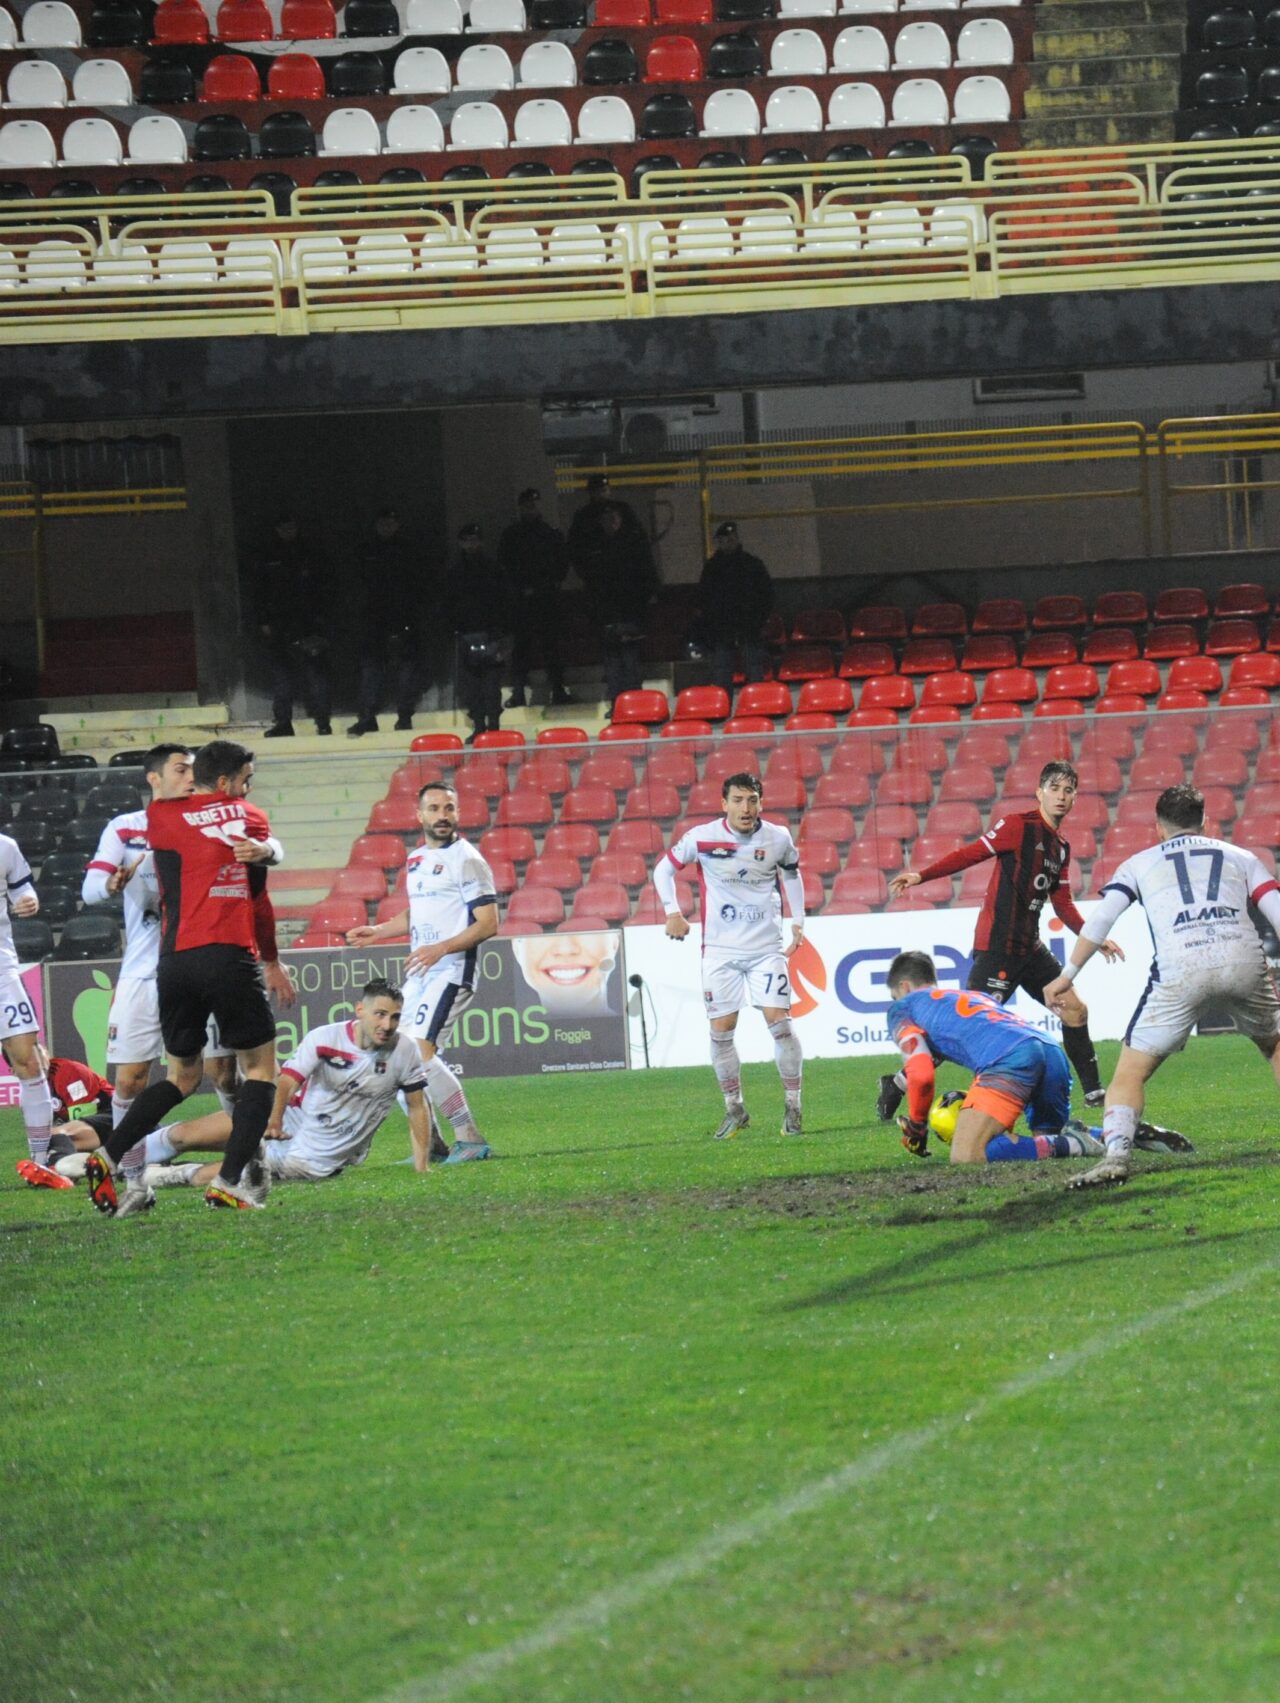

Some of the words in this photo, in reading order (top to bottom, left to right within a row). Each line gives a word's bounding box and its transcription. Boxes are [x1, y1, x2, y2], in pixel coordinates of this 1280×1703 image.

[181, 803, 248, 827] BERETTA
[1165, 848, 1225, 905] 17
[763, 973, 789, 996] 72
[4, 1001, 34, 1029] 29
[415, 1003, 429, 1026] 6
[554, 1027, 592, 1045] Foggia
